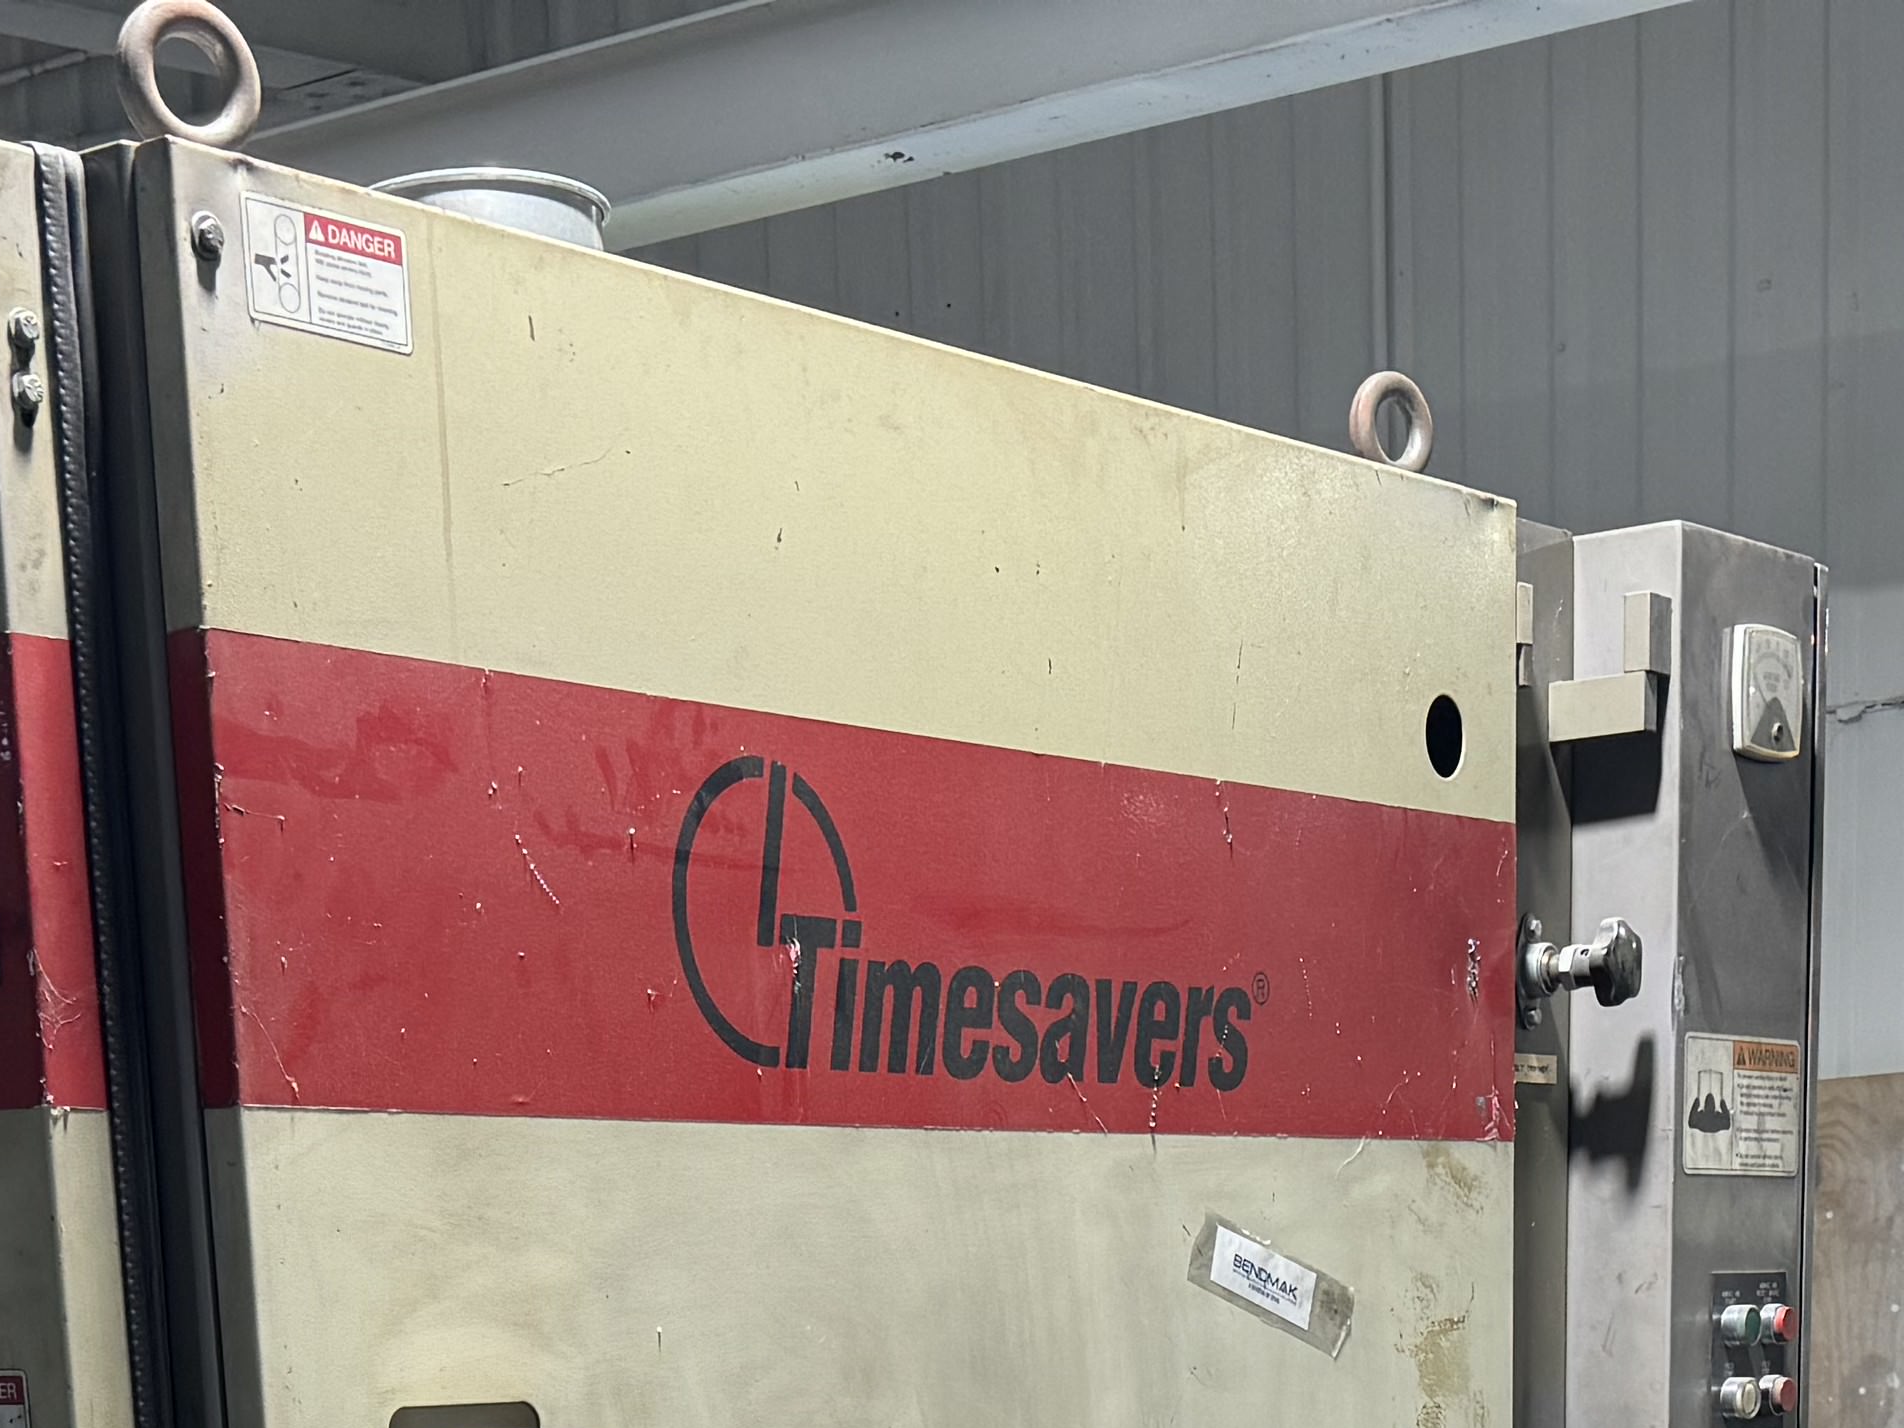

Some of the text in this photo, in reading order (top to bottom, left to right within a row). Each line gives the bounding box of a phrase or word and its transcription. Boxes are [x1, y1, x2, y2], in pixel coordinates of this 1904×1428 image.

[328, 224, 395, 258] DANGER
[1747, 1046, 1796, 1069] WARNING
[1232, 1253, 1298, 1301] BENDMAK
